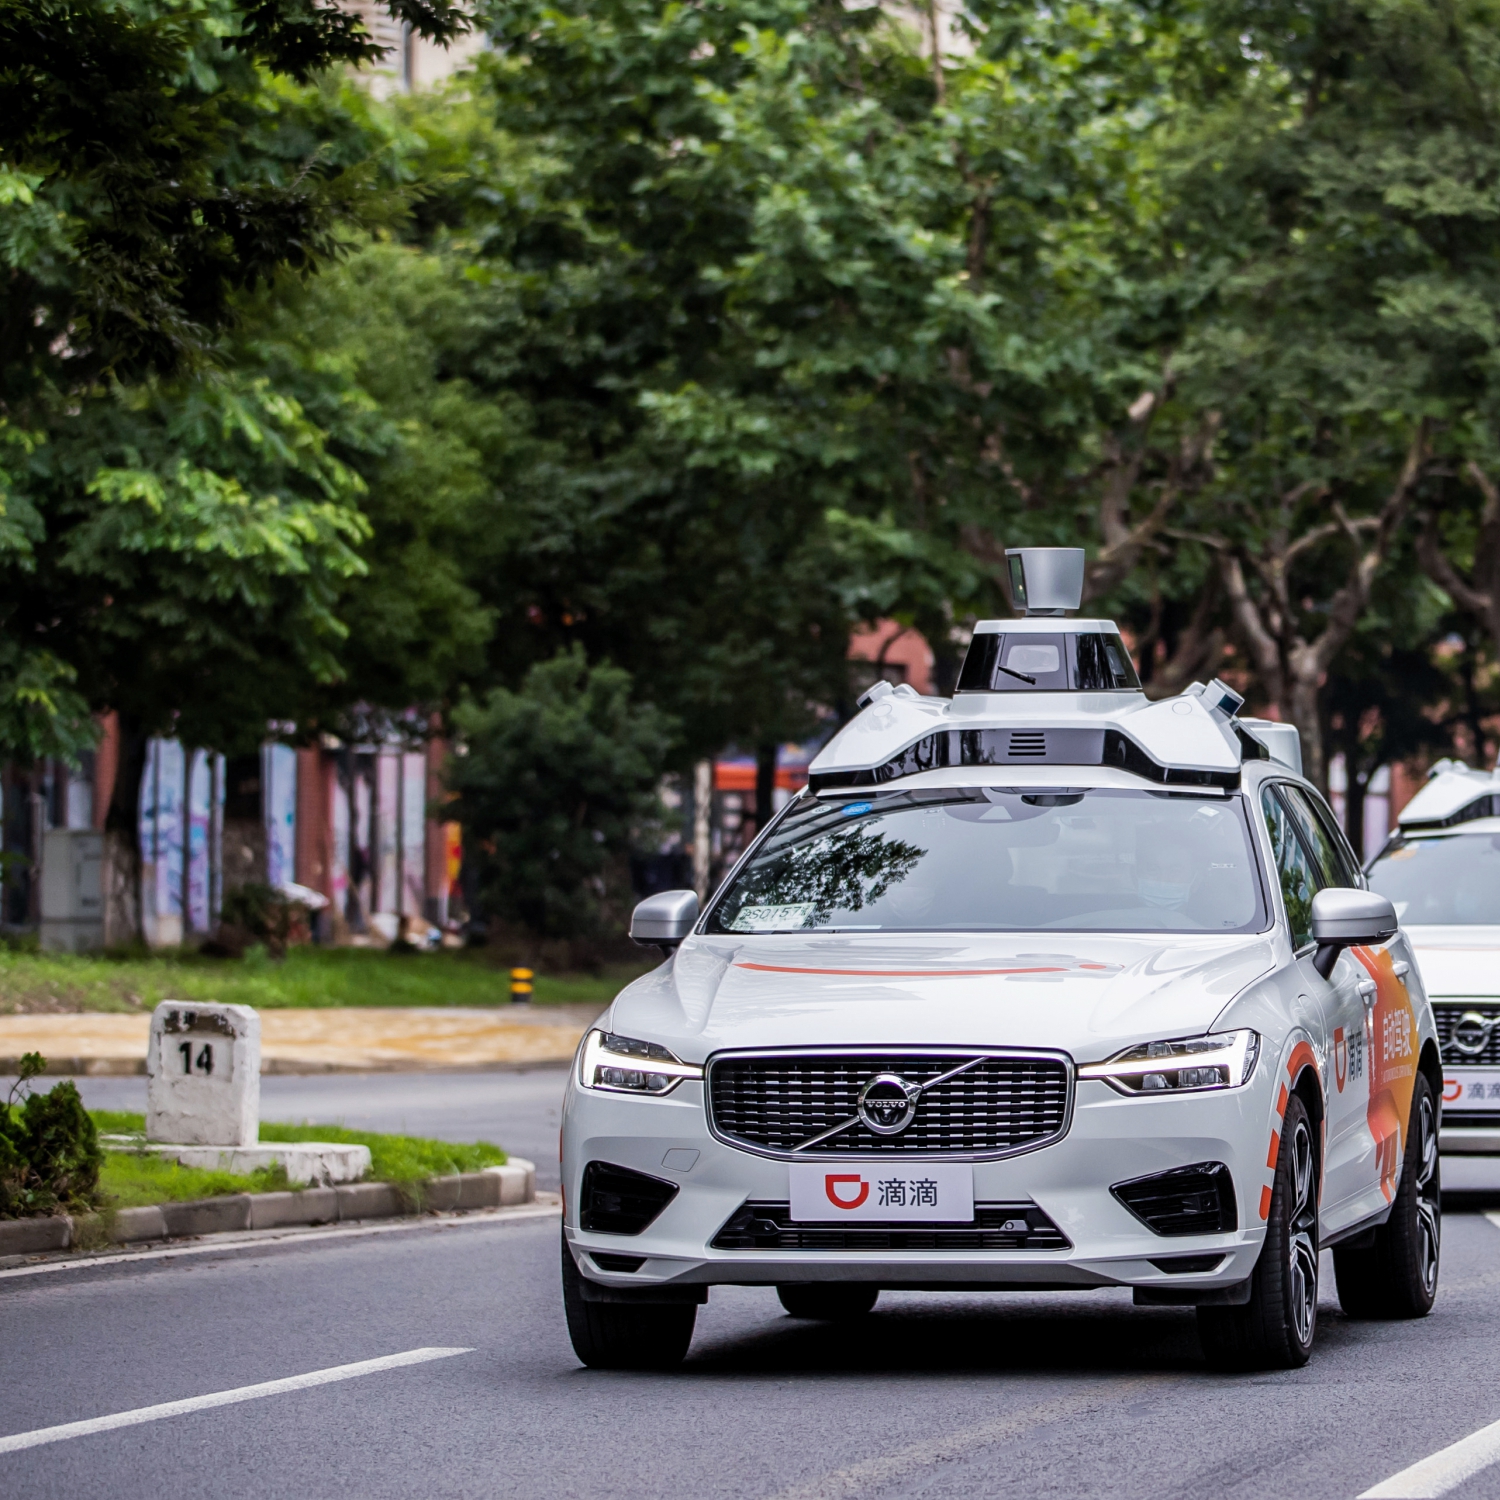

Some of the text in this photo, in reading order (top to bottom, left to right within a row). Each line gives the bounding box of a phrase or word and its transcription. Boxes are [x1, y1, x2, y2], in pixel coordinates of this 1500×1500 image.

[1383, 1006, 1412, 1062] 自动驾驶
[179, 1041, 214, 1076] 14
[877, 1177, 938, 1207] 滴滴
